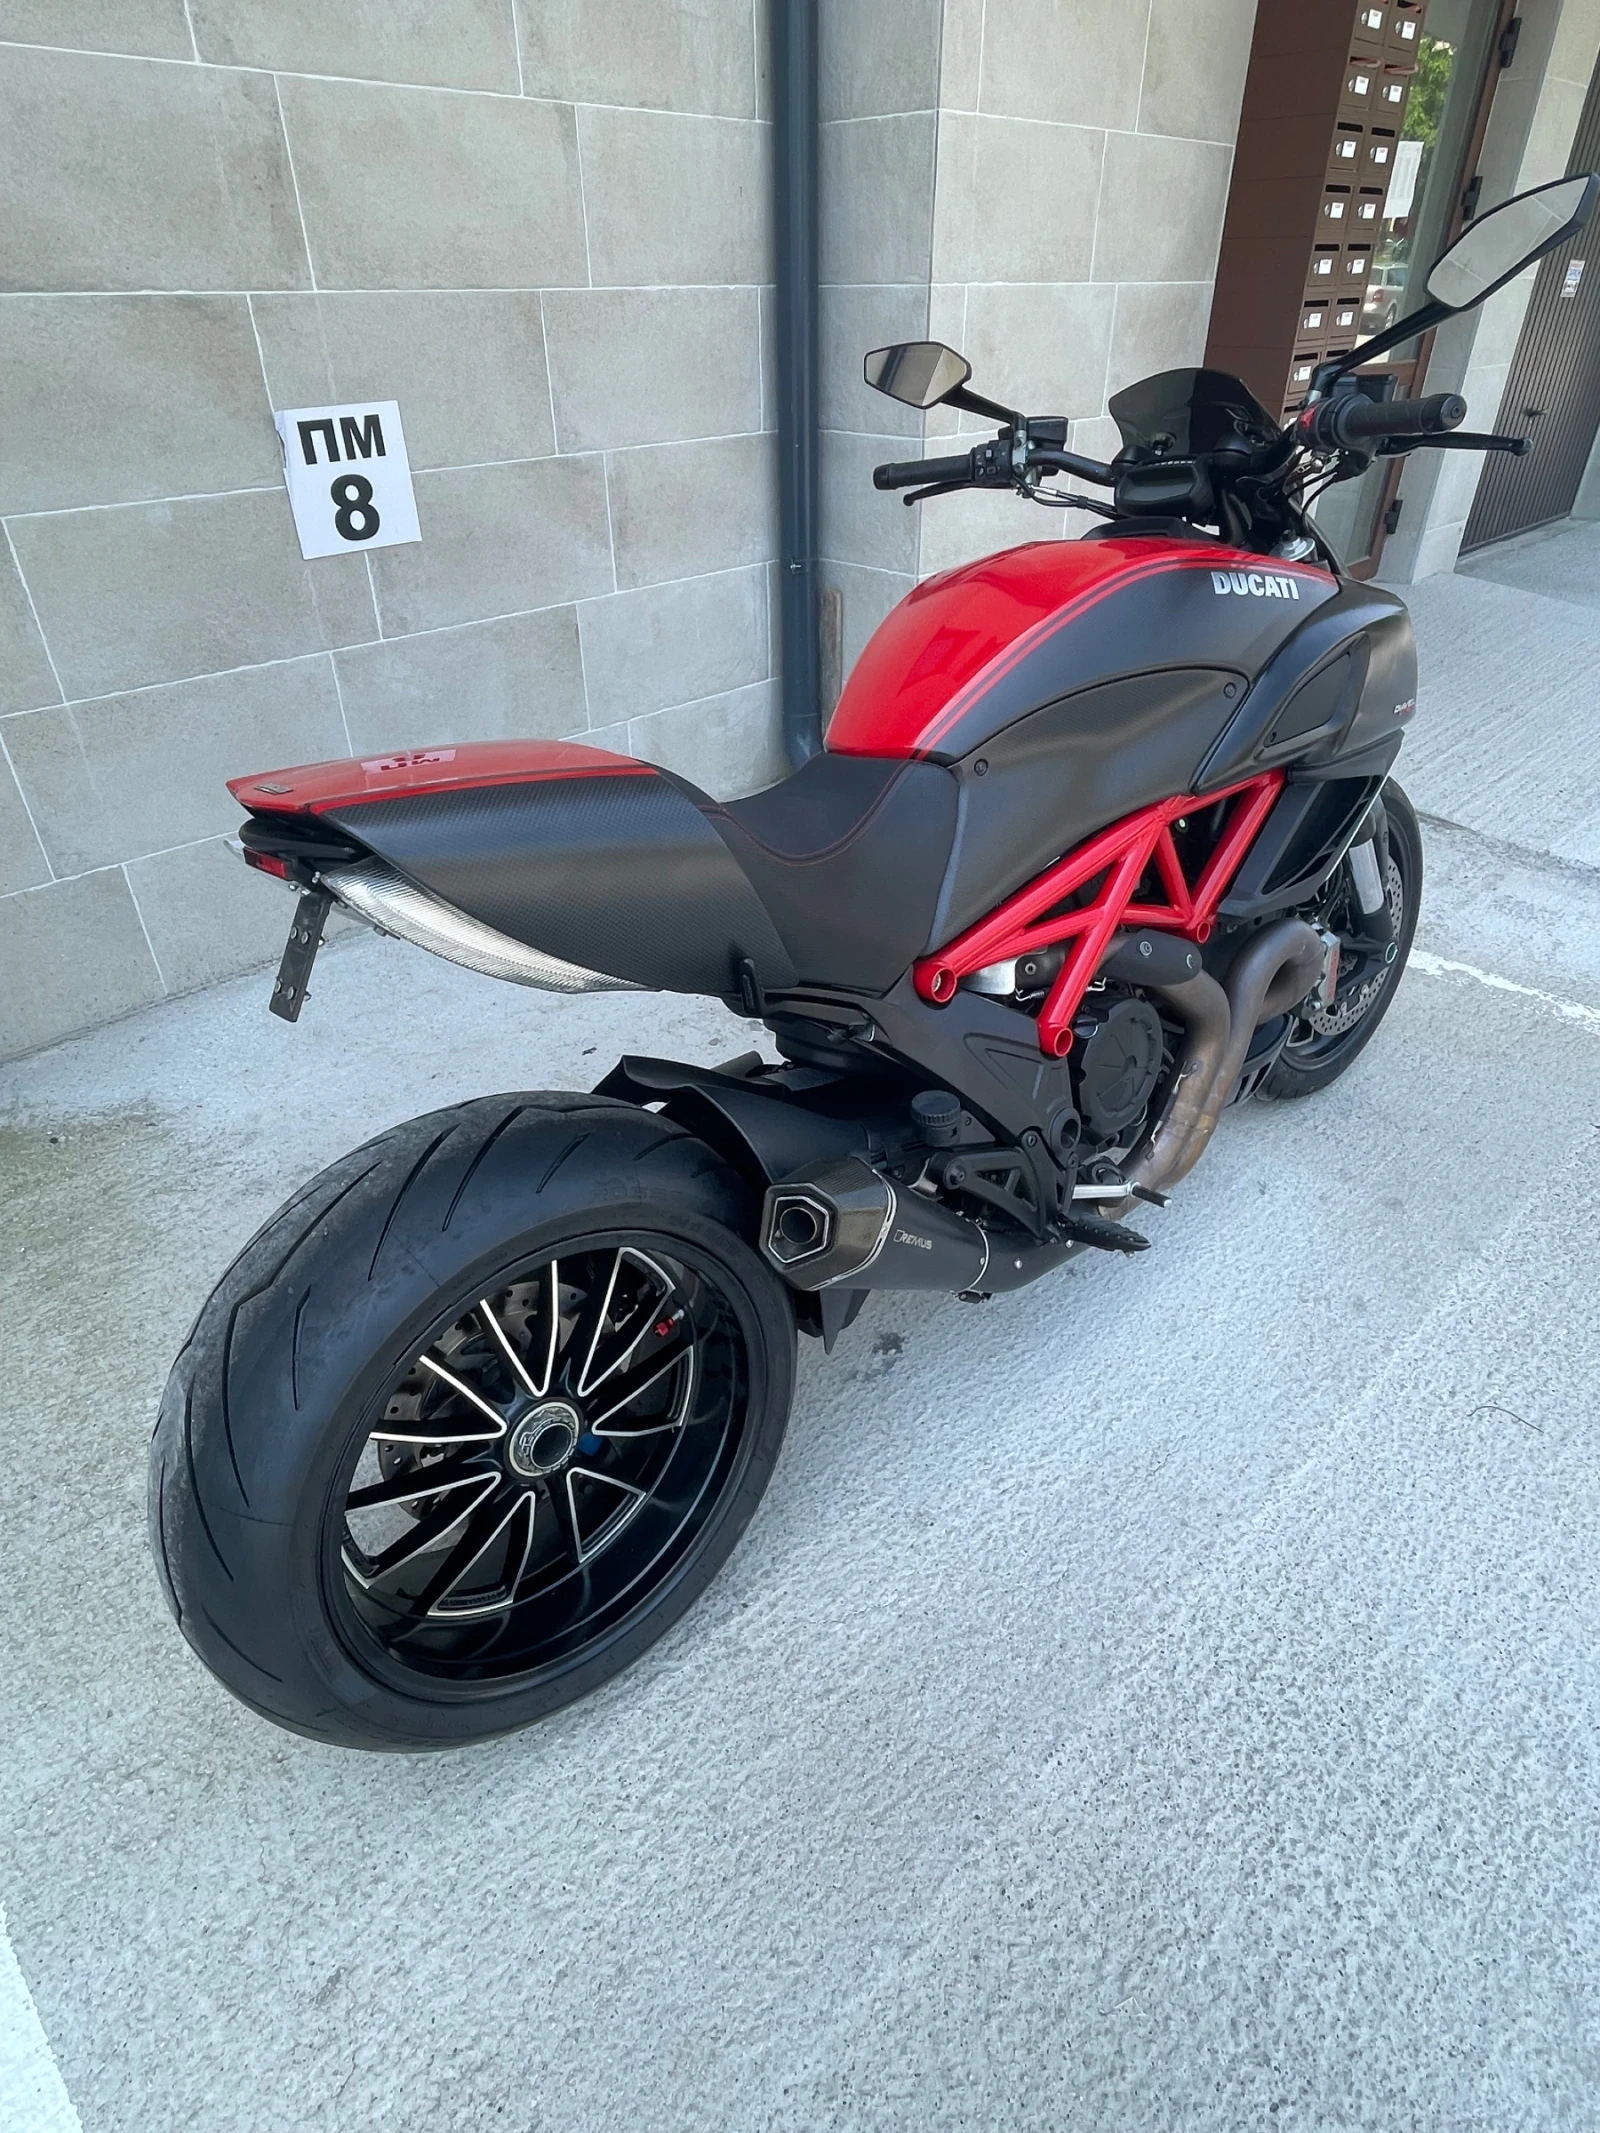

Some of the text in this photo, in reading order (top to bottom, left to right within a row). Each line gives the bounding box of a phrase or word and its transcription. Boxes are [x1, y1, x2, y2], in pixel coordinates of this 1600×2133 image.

[296, 414, 386, 466] ПМ
[330, 474, 380, 541] 8
[1210, 571, 1300, 600] DUCATI
[900, 1231, 933, 1250] REMUS
